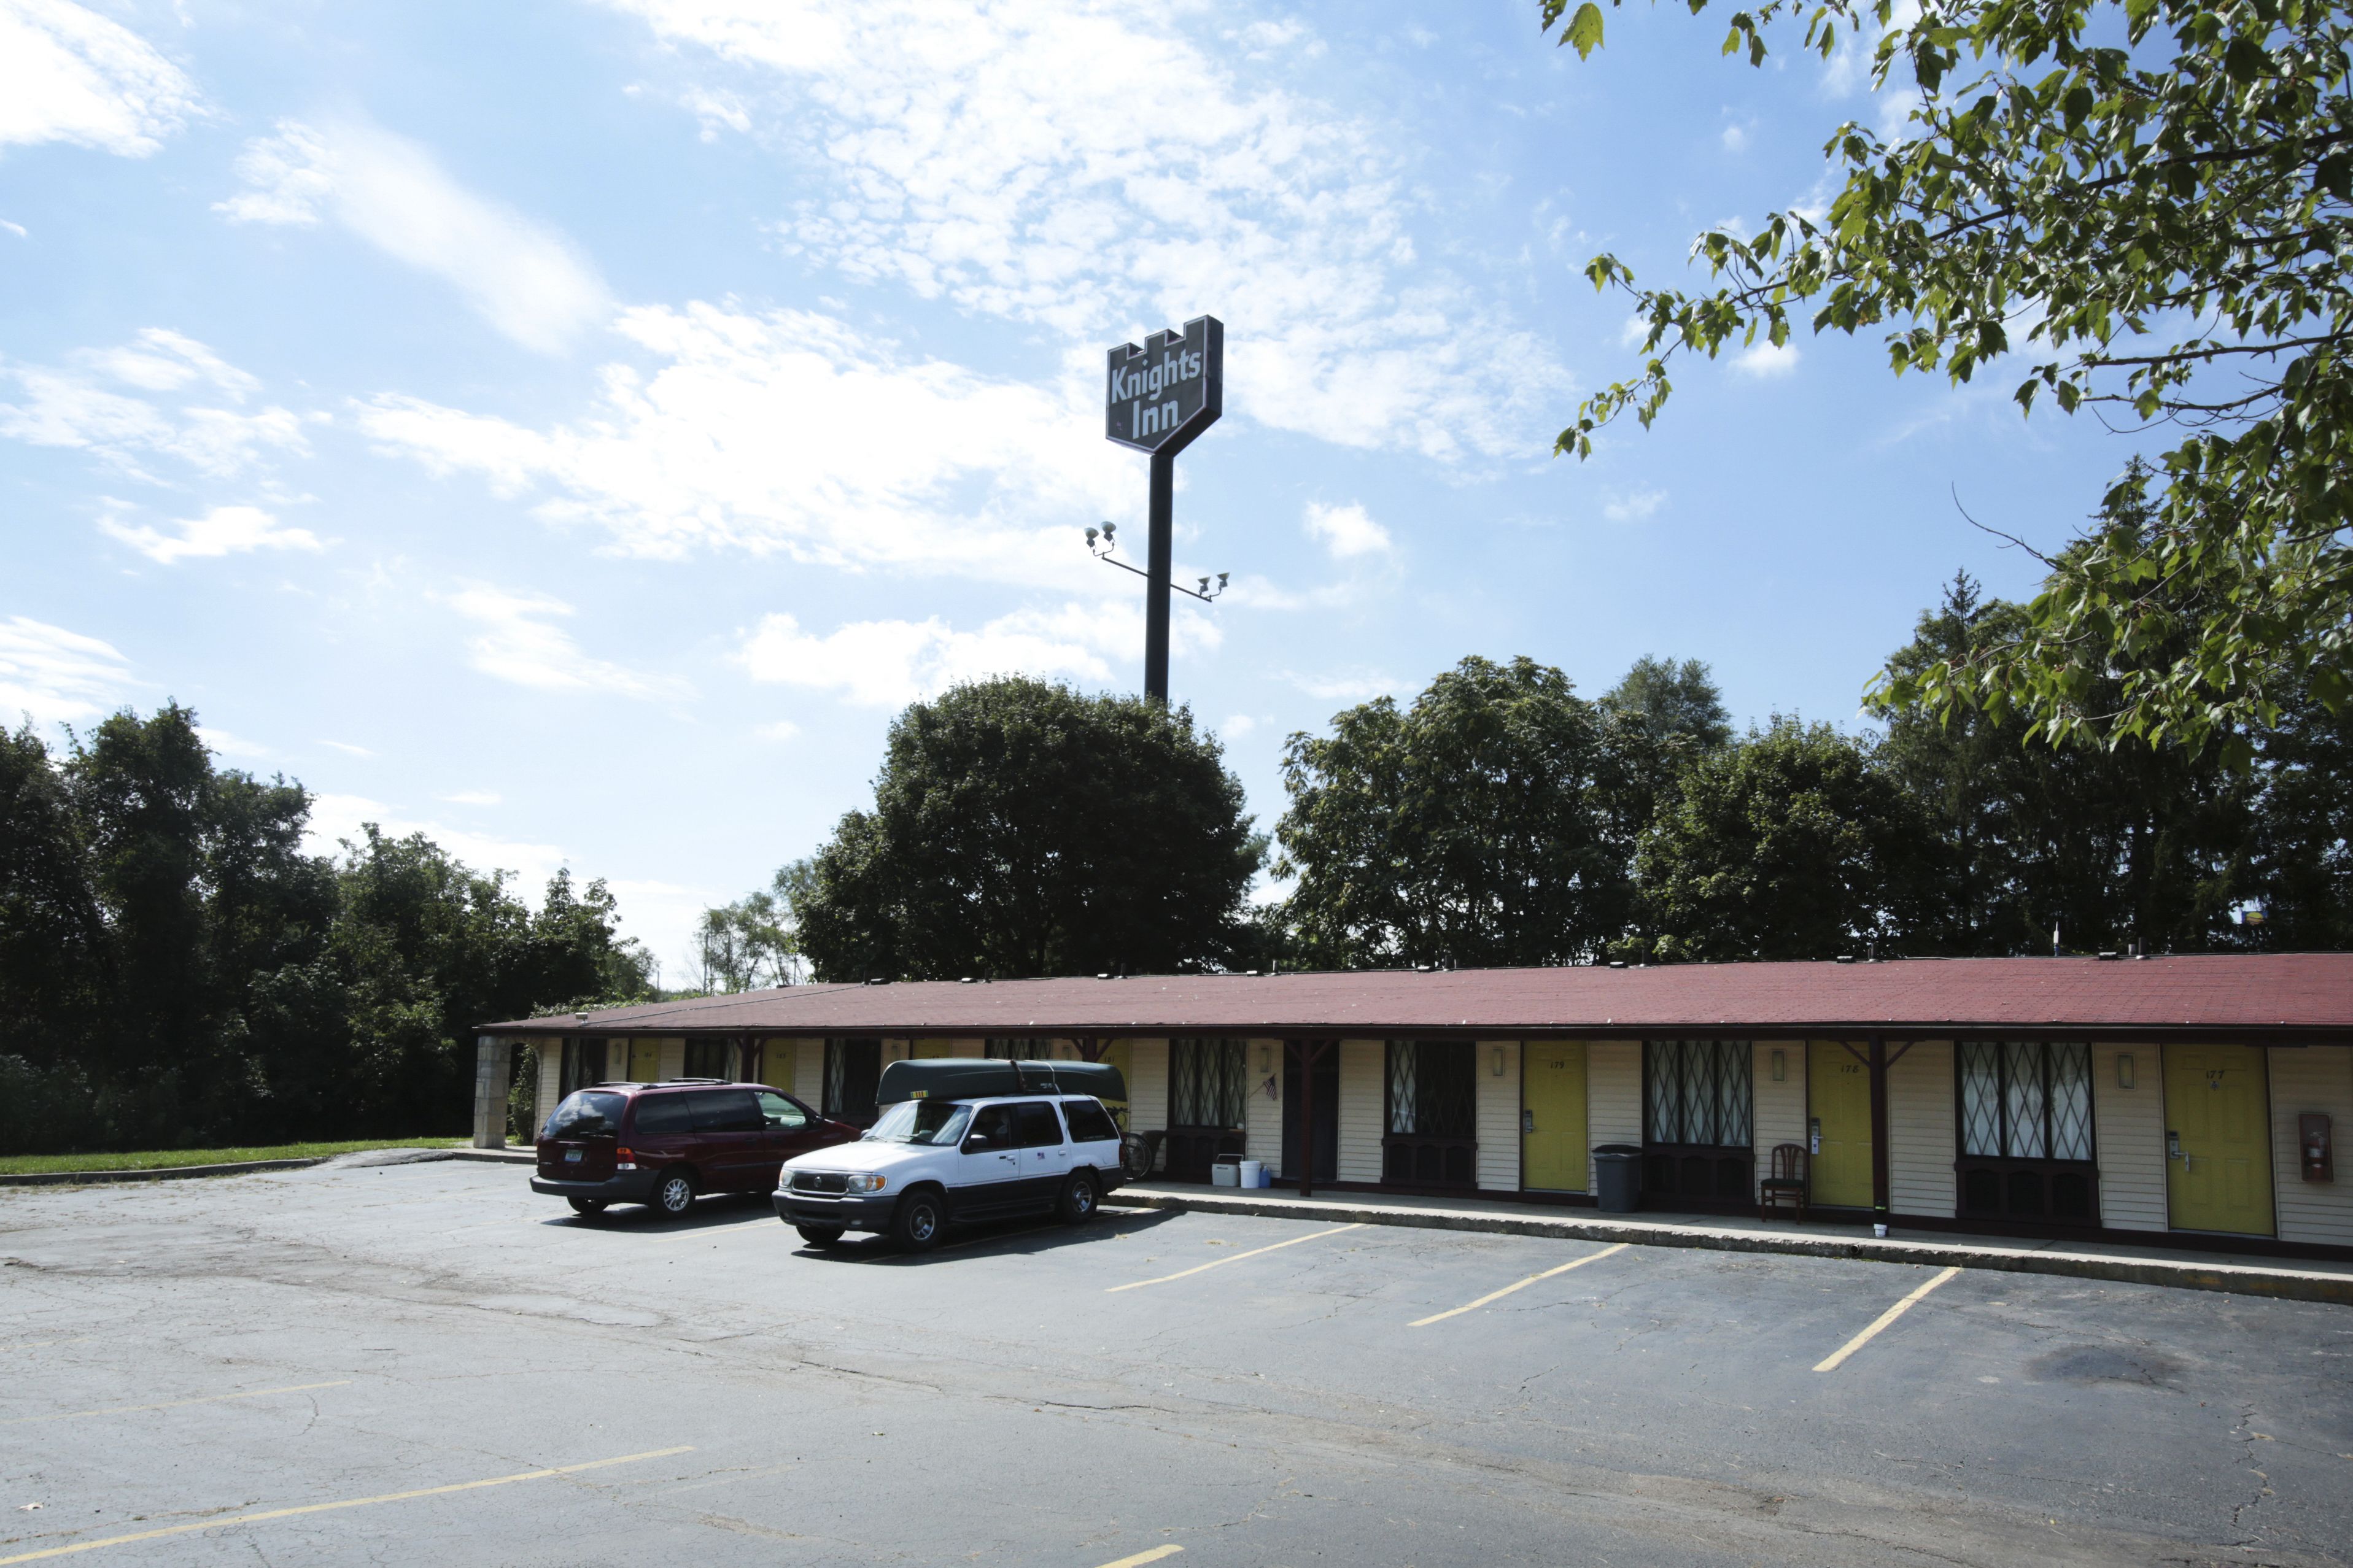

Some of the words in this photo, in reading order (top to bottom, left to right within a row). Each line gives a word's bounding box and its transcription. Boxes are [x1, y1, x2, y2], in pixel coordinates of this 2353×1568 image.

[1111, 349, 1201, 401] Knights
[1133, 400, 1179, 439] Inn
[1841, 1065, 1859, 1073] 178
[2206, 1070, 2225, 1079] 177
